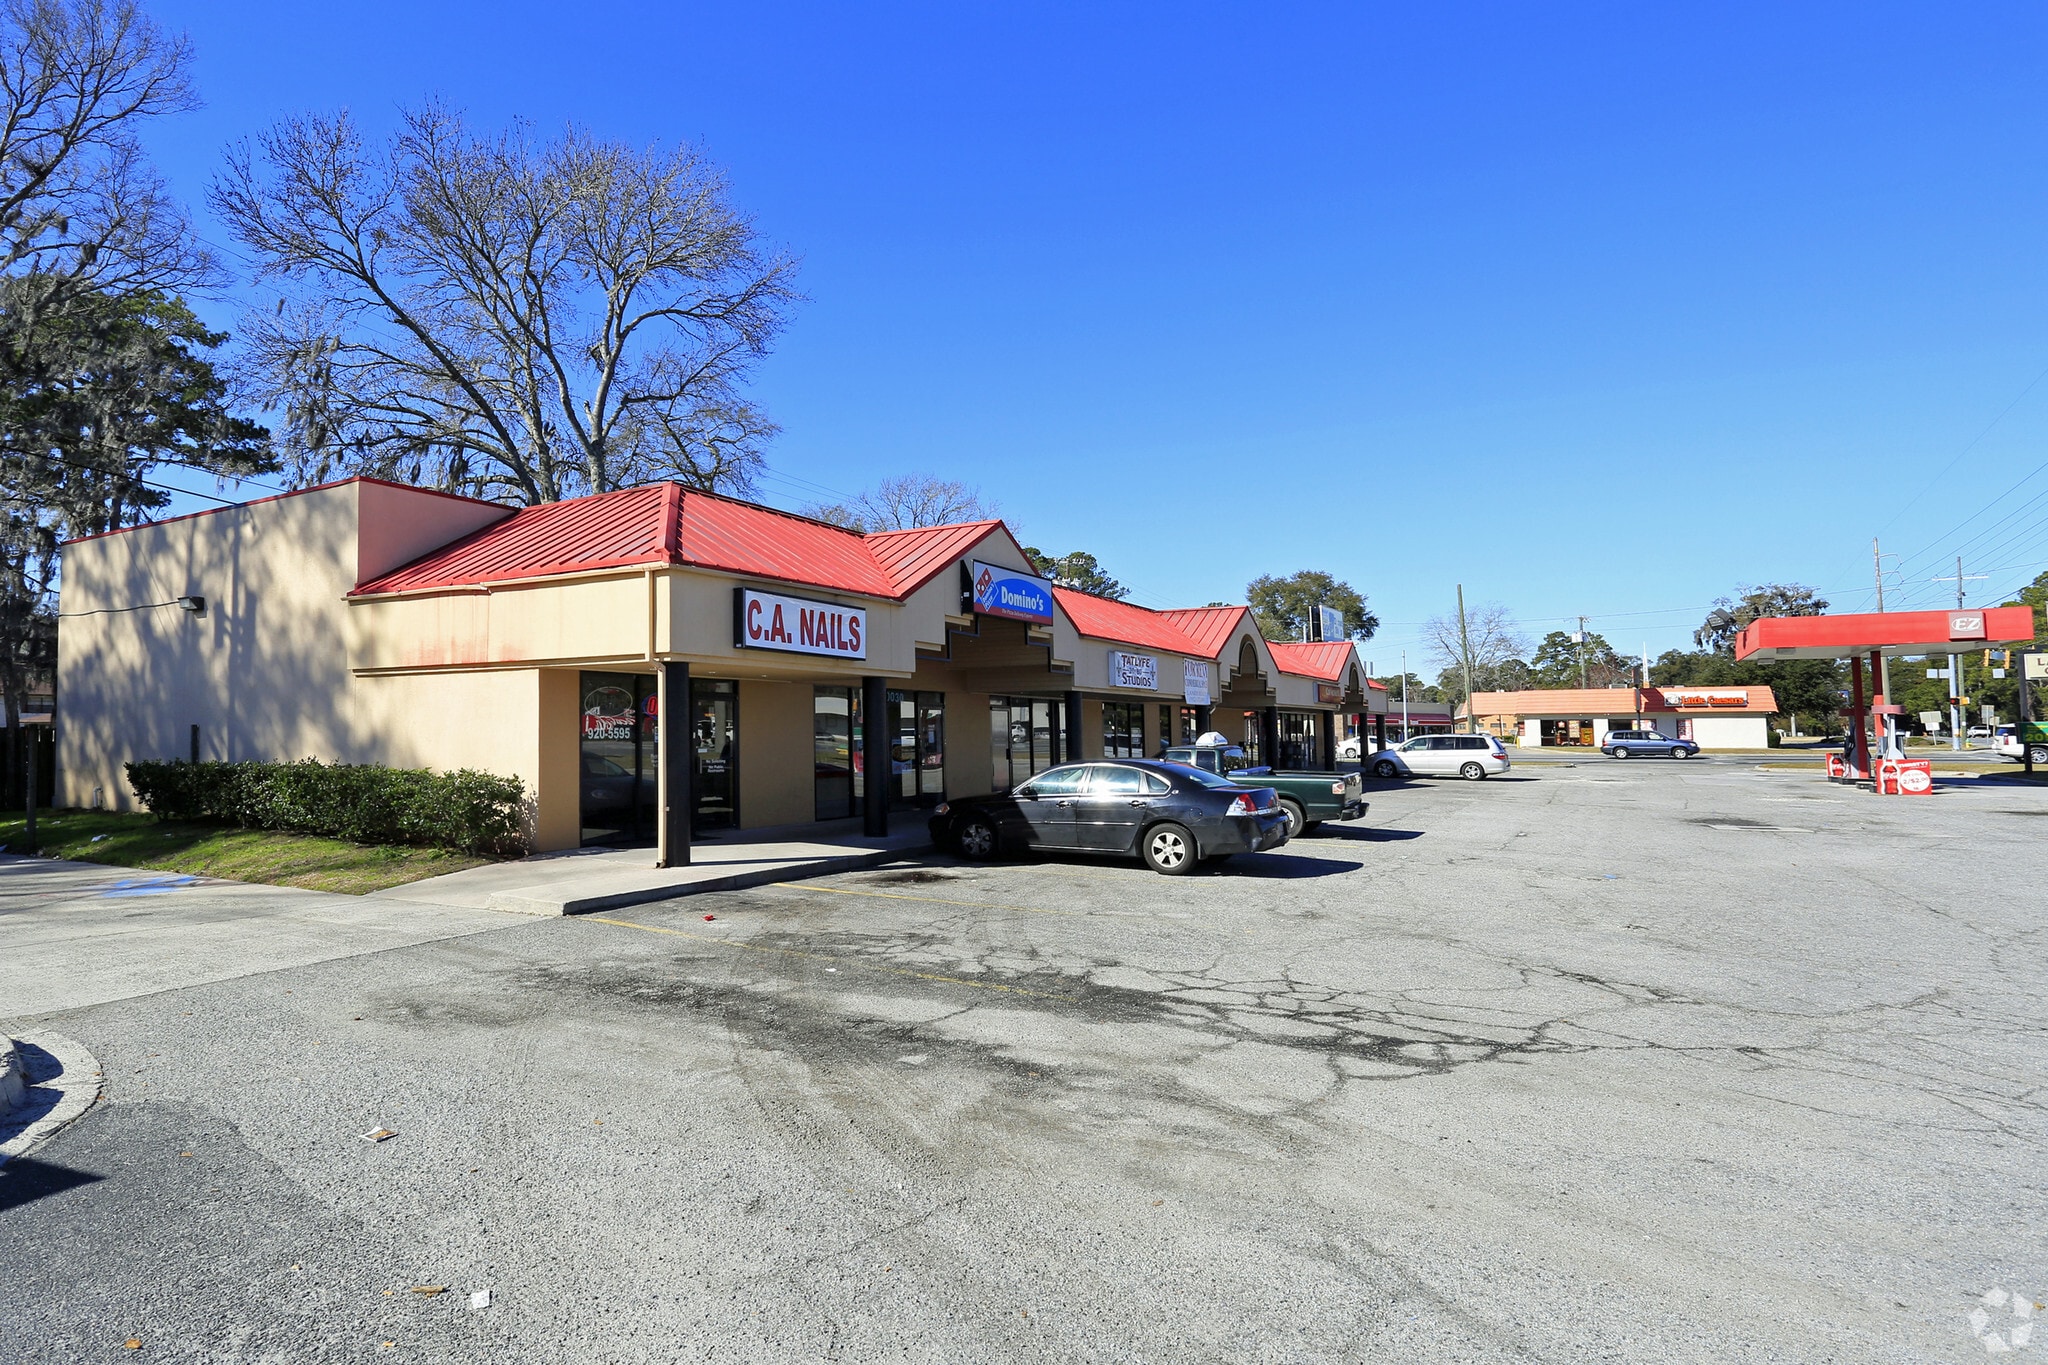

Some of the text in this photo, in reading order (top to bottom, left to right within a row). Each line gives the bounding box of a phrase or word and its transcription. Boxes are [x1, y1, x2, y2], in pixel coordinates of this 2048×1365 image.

[1001, 586, 1044, 611] Domino's
[747, 599, 861, 652] C.A. NAILS
[1955, 617, 1980, 631] EZ
[1121, 654, 1150, 668] TATLYFE
[2037, 658, 2048, 666] L
[1122, 671, 1152, 687] STUDIOS
[1681, 695, 1745, 705] Little Caesars
[588, 727, 631, 739] 920-5595
[2025, 733, 2048, 741] 20
